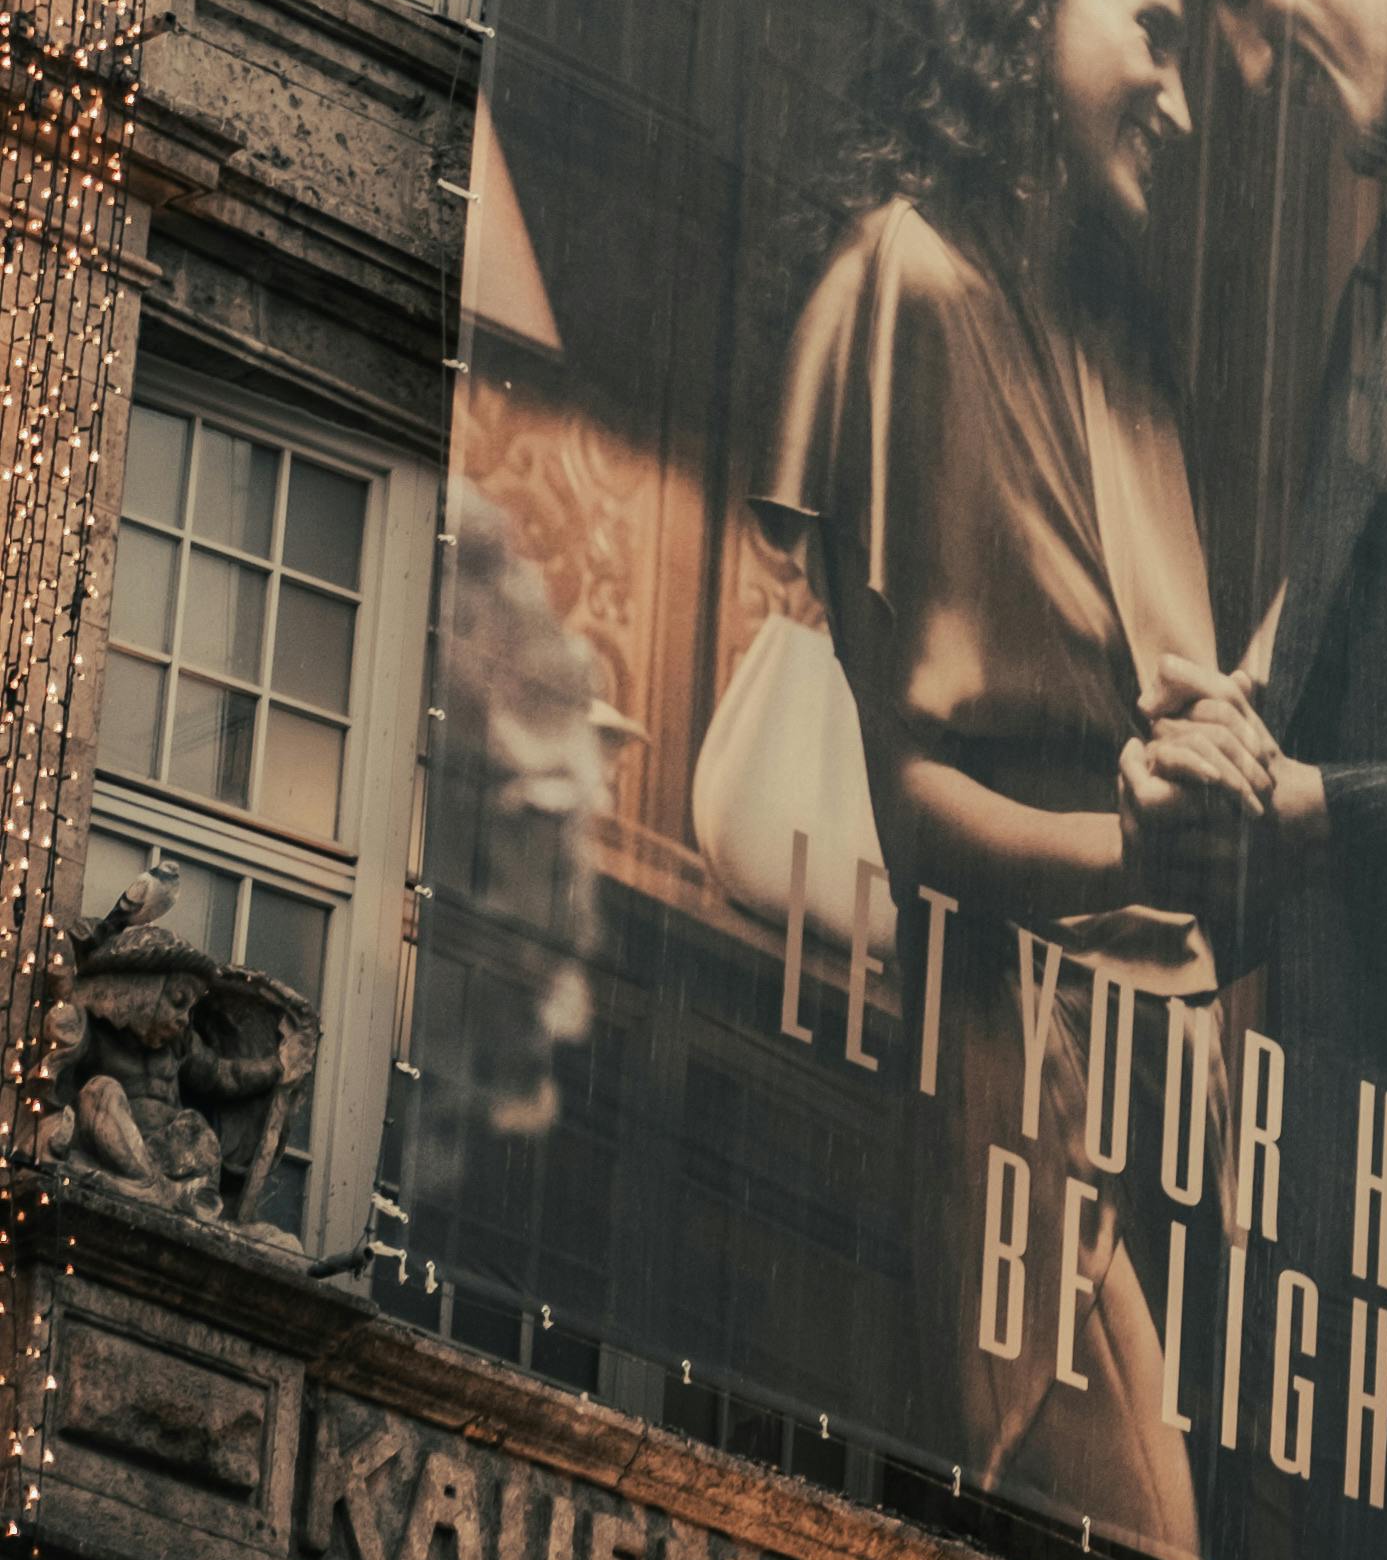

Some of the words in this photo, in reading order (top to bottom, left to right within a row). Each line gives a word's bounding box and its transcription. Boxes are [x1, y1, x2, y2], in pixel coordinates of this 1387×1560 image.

[780, 829, 959, 1097] LET
[1016, 925, 1286, 1242] YOUR
[978, 1143, 1098, 1391] BE
